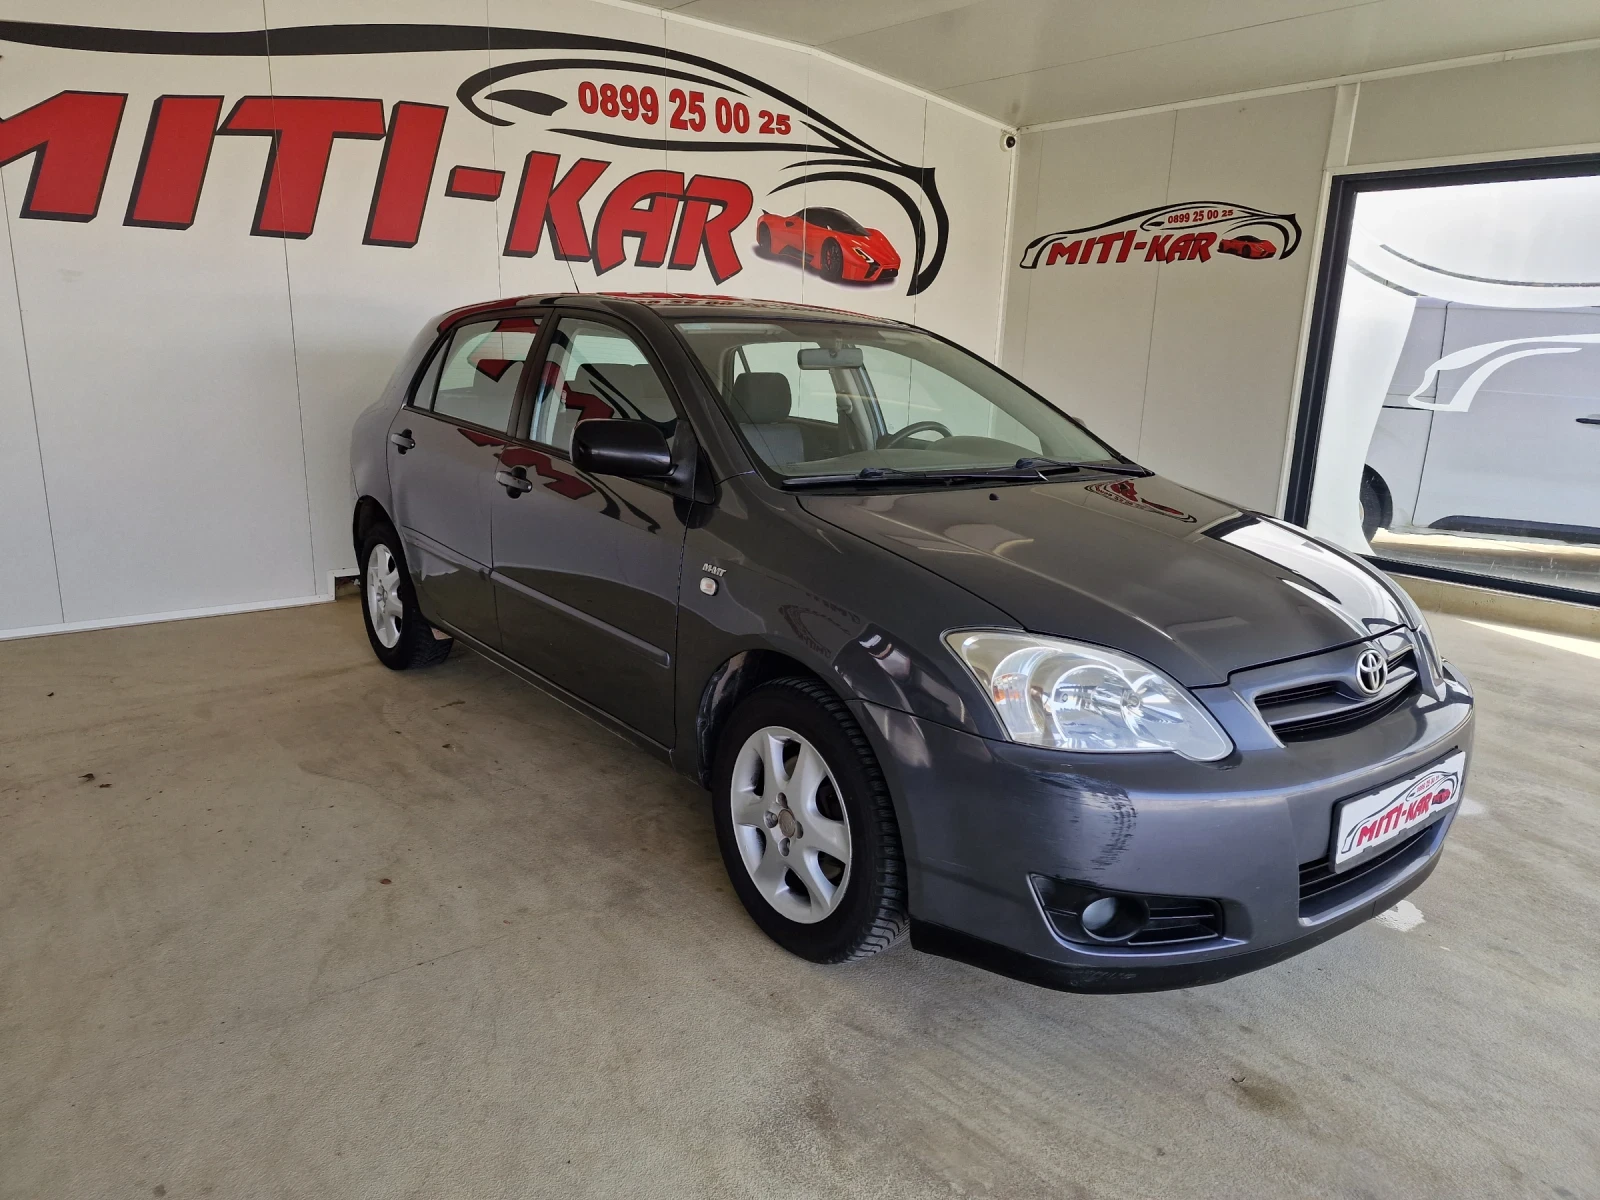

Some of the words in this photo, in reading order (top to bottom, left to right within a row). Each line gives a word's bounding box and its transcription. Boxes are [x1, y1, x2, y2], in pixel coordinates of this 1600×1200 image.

[578, 81, 660, 125] 0899
[668, 88, 706, 132] 25
[715, 97, 750, 134] 00
[758, 110, 792, 135] 25
[1167, 212, 1190, 224] 0899
[1192, 210, 1205, 221] 25
[1206, 209, 1219, 220] 00
[1221, 209, 1234, 218] 25
[1045, 229, 1217, 264] MITI-KAR
[1356, 791, 1433, 847] MITI-KAR
